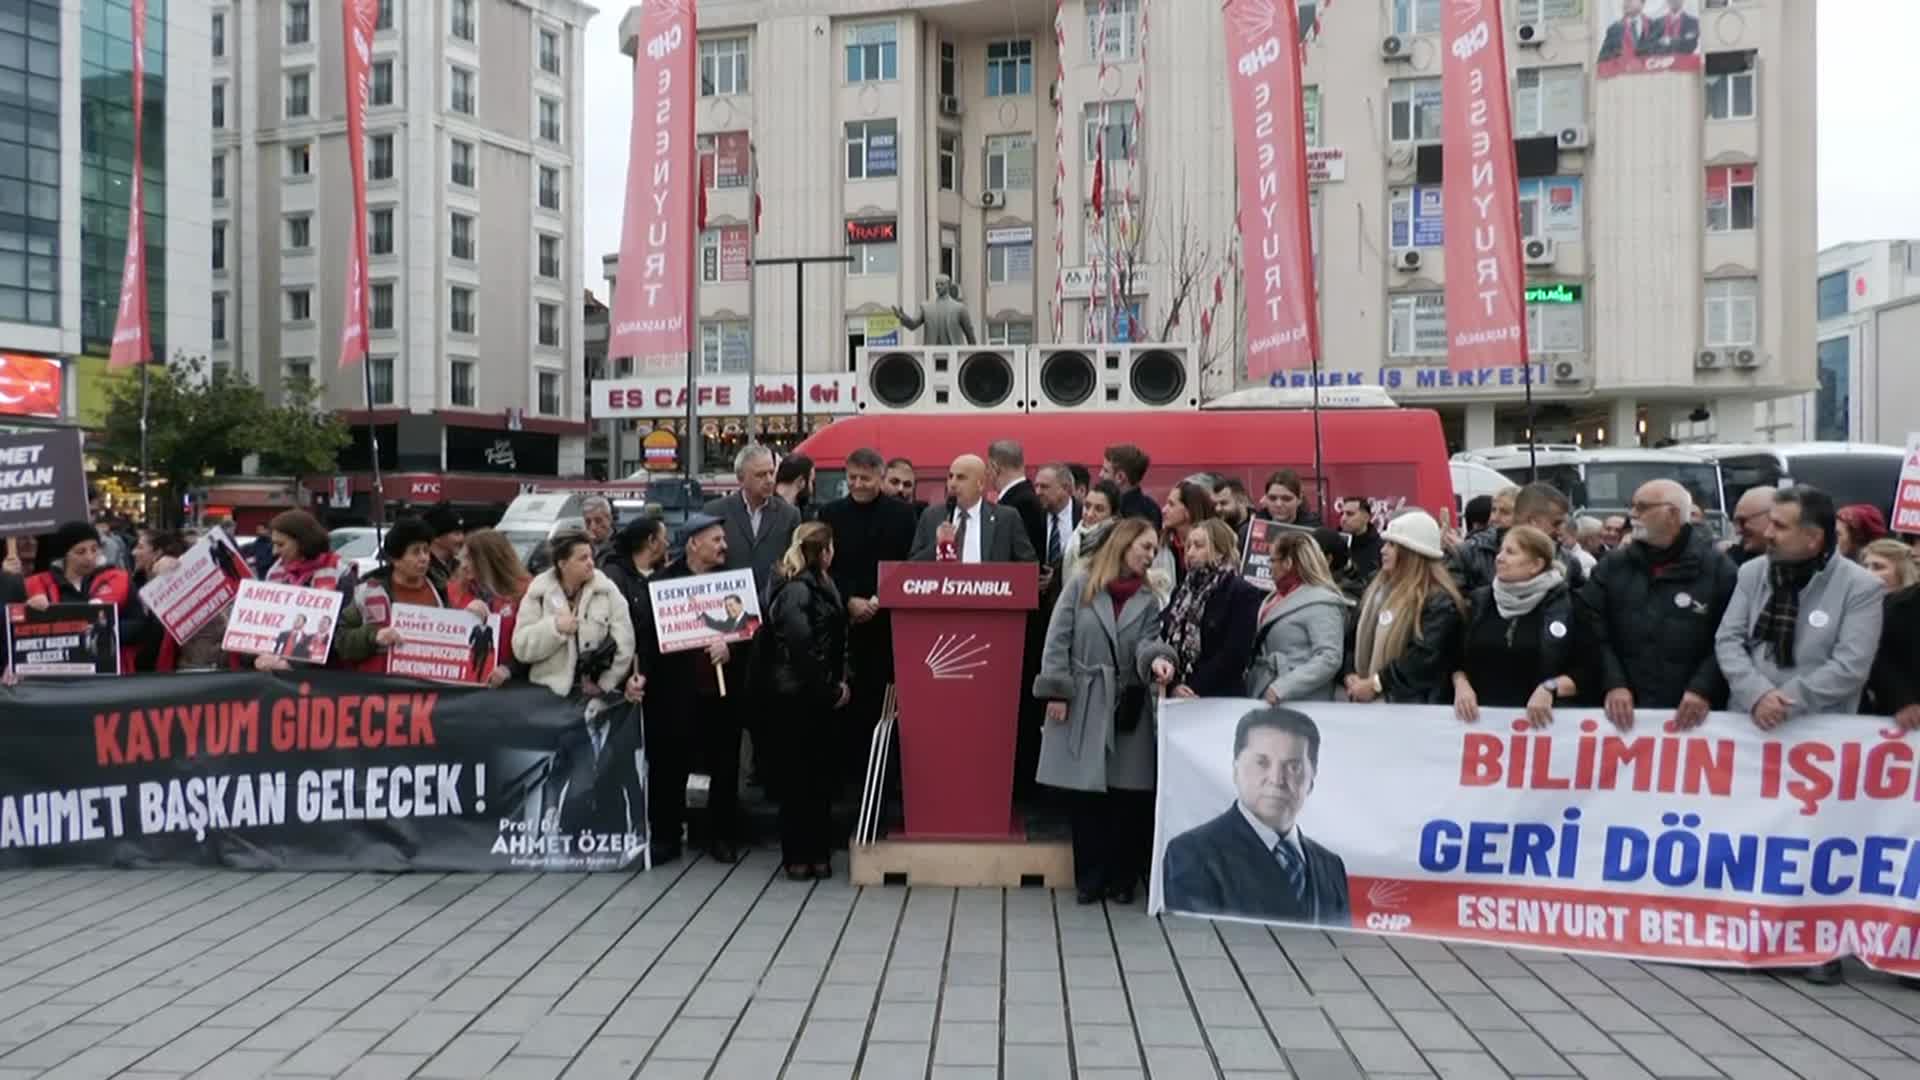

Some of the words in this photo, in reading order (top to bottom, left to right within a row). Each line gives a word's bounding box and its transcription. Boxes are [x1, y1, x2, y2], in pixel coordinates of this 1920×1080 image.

[608, 388, 643, 408] ES
[412, 483, 441, 494] KFC
[244, 585, 293, 602] AHMET
[298, 589, 334, 609] ÖZER
[903, 578, 939, 595] CHP
[942, 576, 1013, 596] İSTANBUL
[394, 620, 434, 633] AHMET
[94, 699, 260, 766] KAYYUM
[271, 682, 438, 752] GİDECEK
[1460, 718, 1735, 797] BİLİMİN
[0, 785, 127, 848] AHMET
[139, 770, 286, 843] BAŞKAN
[297, 763, 463, 824] GELECEK
[475, 763, 486, 813] !
[490, 834, 573, 855] AHMET
[578, 829, 638, 853] ÖZER
[1418, 807, 1582, 879] GERİ
[1366, 911, 1411, 931] CHP
[1458, 894, 1630, 941] ESENYURT
[1640, 908, 1805, 953] BELEDİYE
[1815, 919, 1920, 960] BAŞKA
